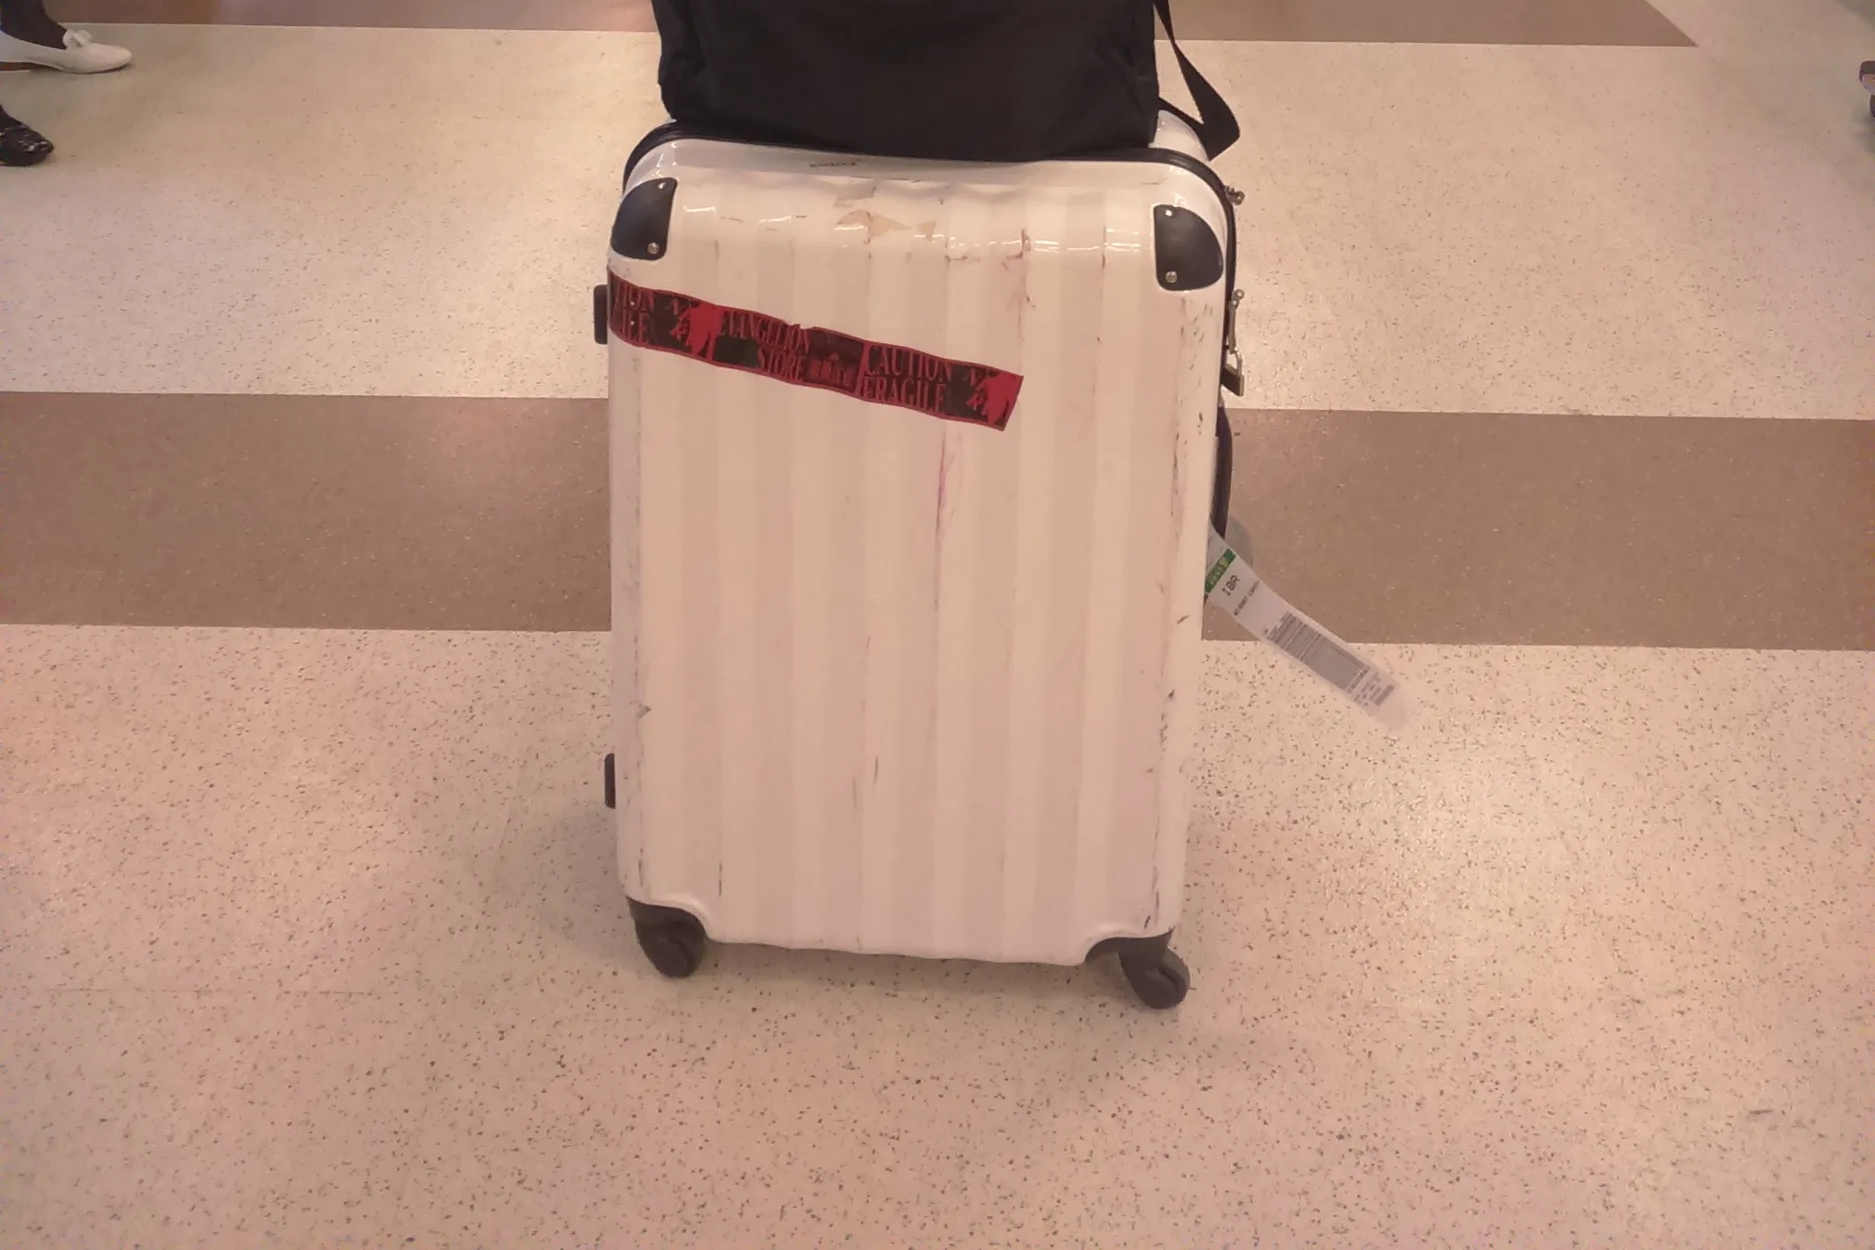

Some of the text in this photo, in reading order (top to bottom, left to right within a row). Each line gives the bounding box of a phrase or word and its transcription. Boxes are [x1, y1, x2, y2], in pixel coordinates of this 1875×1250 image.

[720, 309, 813, 355] EVANGELION
[756, 344, 807, 382] STORE
[864, 344, 953, 383] CAUTION
[863, 376, 947, 414] FRAGILE
[1221, 574, 1241, 597] IBR
